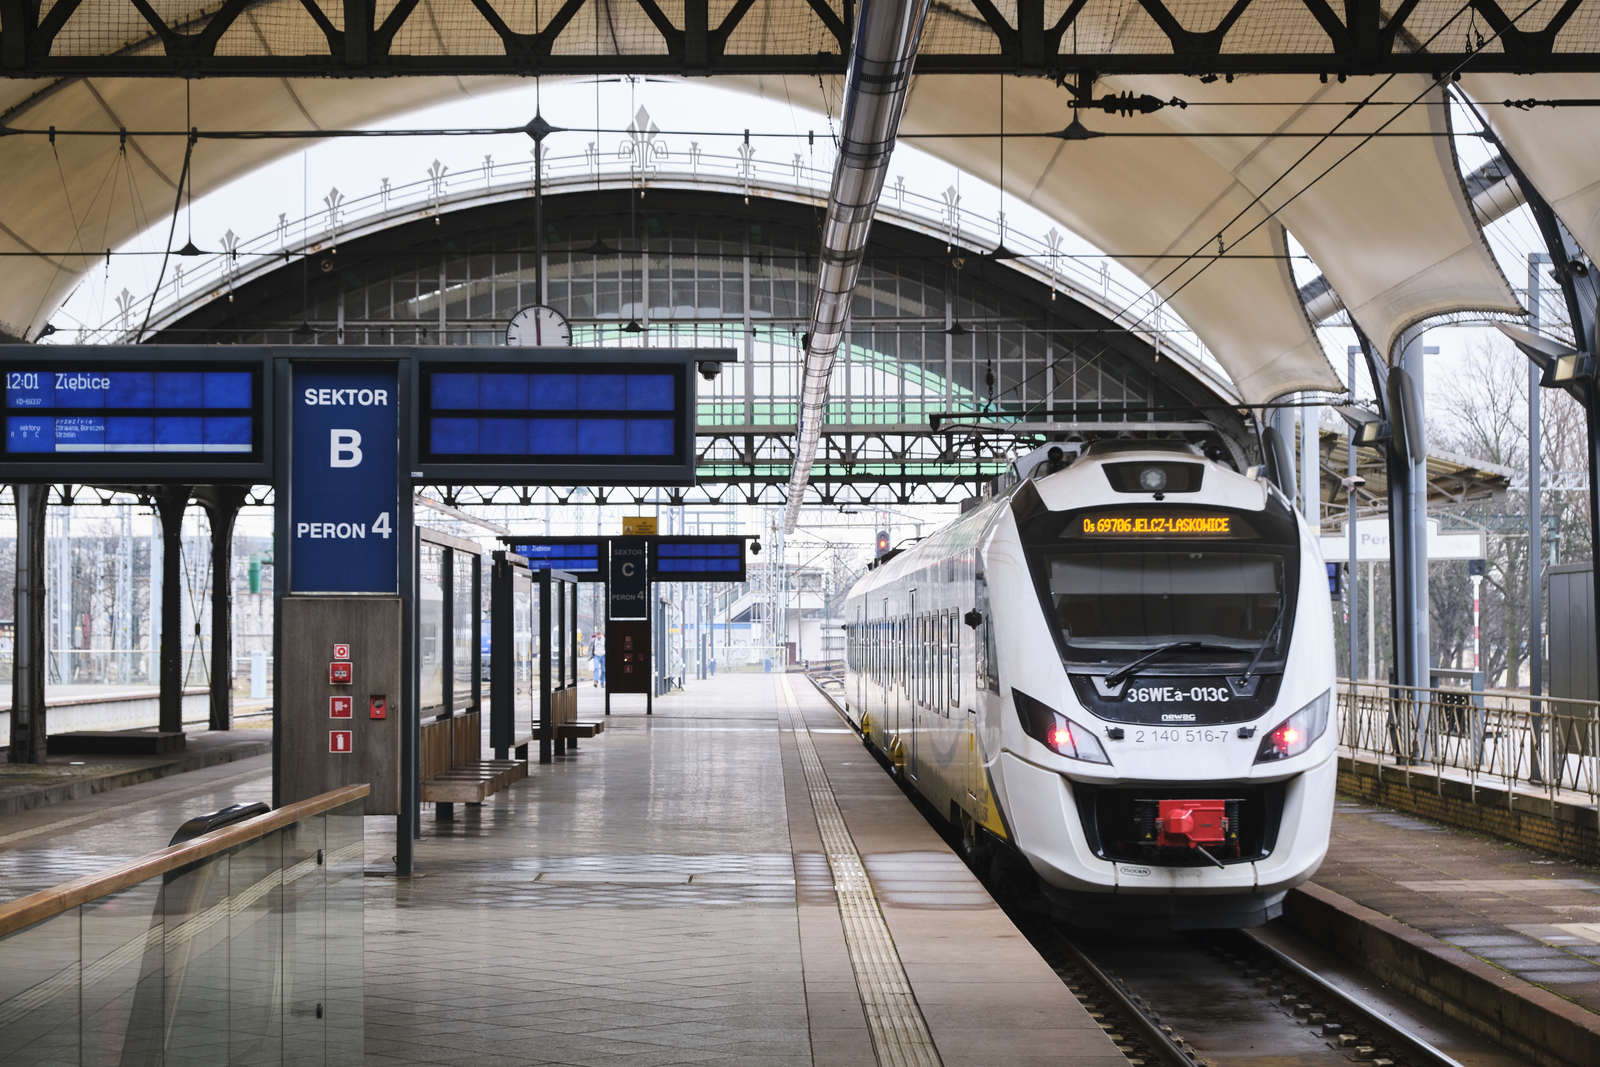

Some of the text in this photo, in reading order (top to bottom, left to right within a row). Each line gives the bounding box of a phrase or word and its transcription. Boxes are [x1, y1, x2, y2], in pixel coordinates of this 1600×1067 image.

[6, 373, 110, 391] 12:01 Ziębice
[304, 389, 388, 406] SEKTOR
[330, 428, 363, 468] B
[297, 512, 392, 539] PERON 4
[1097, 518, 1131, 533] 69706
[1133, 517, 1230, 533] JELCZ-LASKOWICE
[613, 548, 643, 556] SEKTOR
[622, 562, 635, 577] C
[637, 590, 644, 600] 4
[1127, 687, 1229, 703] 36WEa-013C
[1135, 729, 1229, 743] 2 140 516-7
